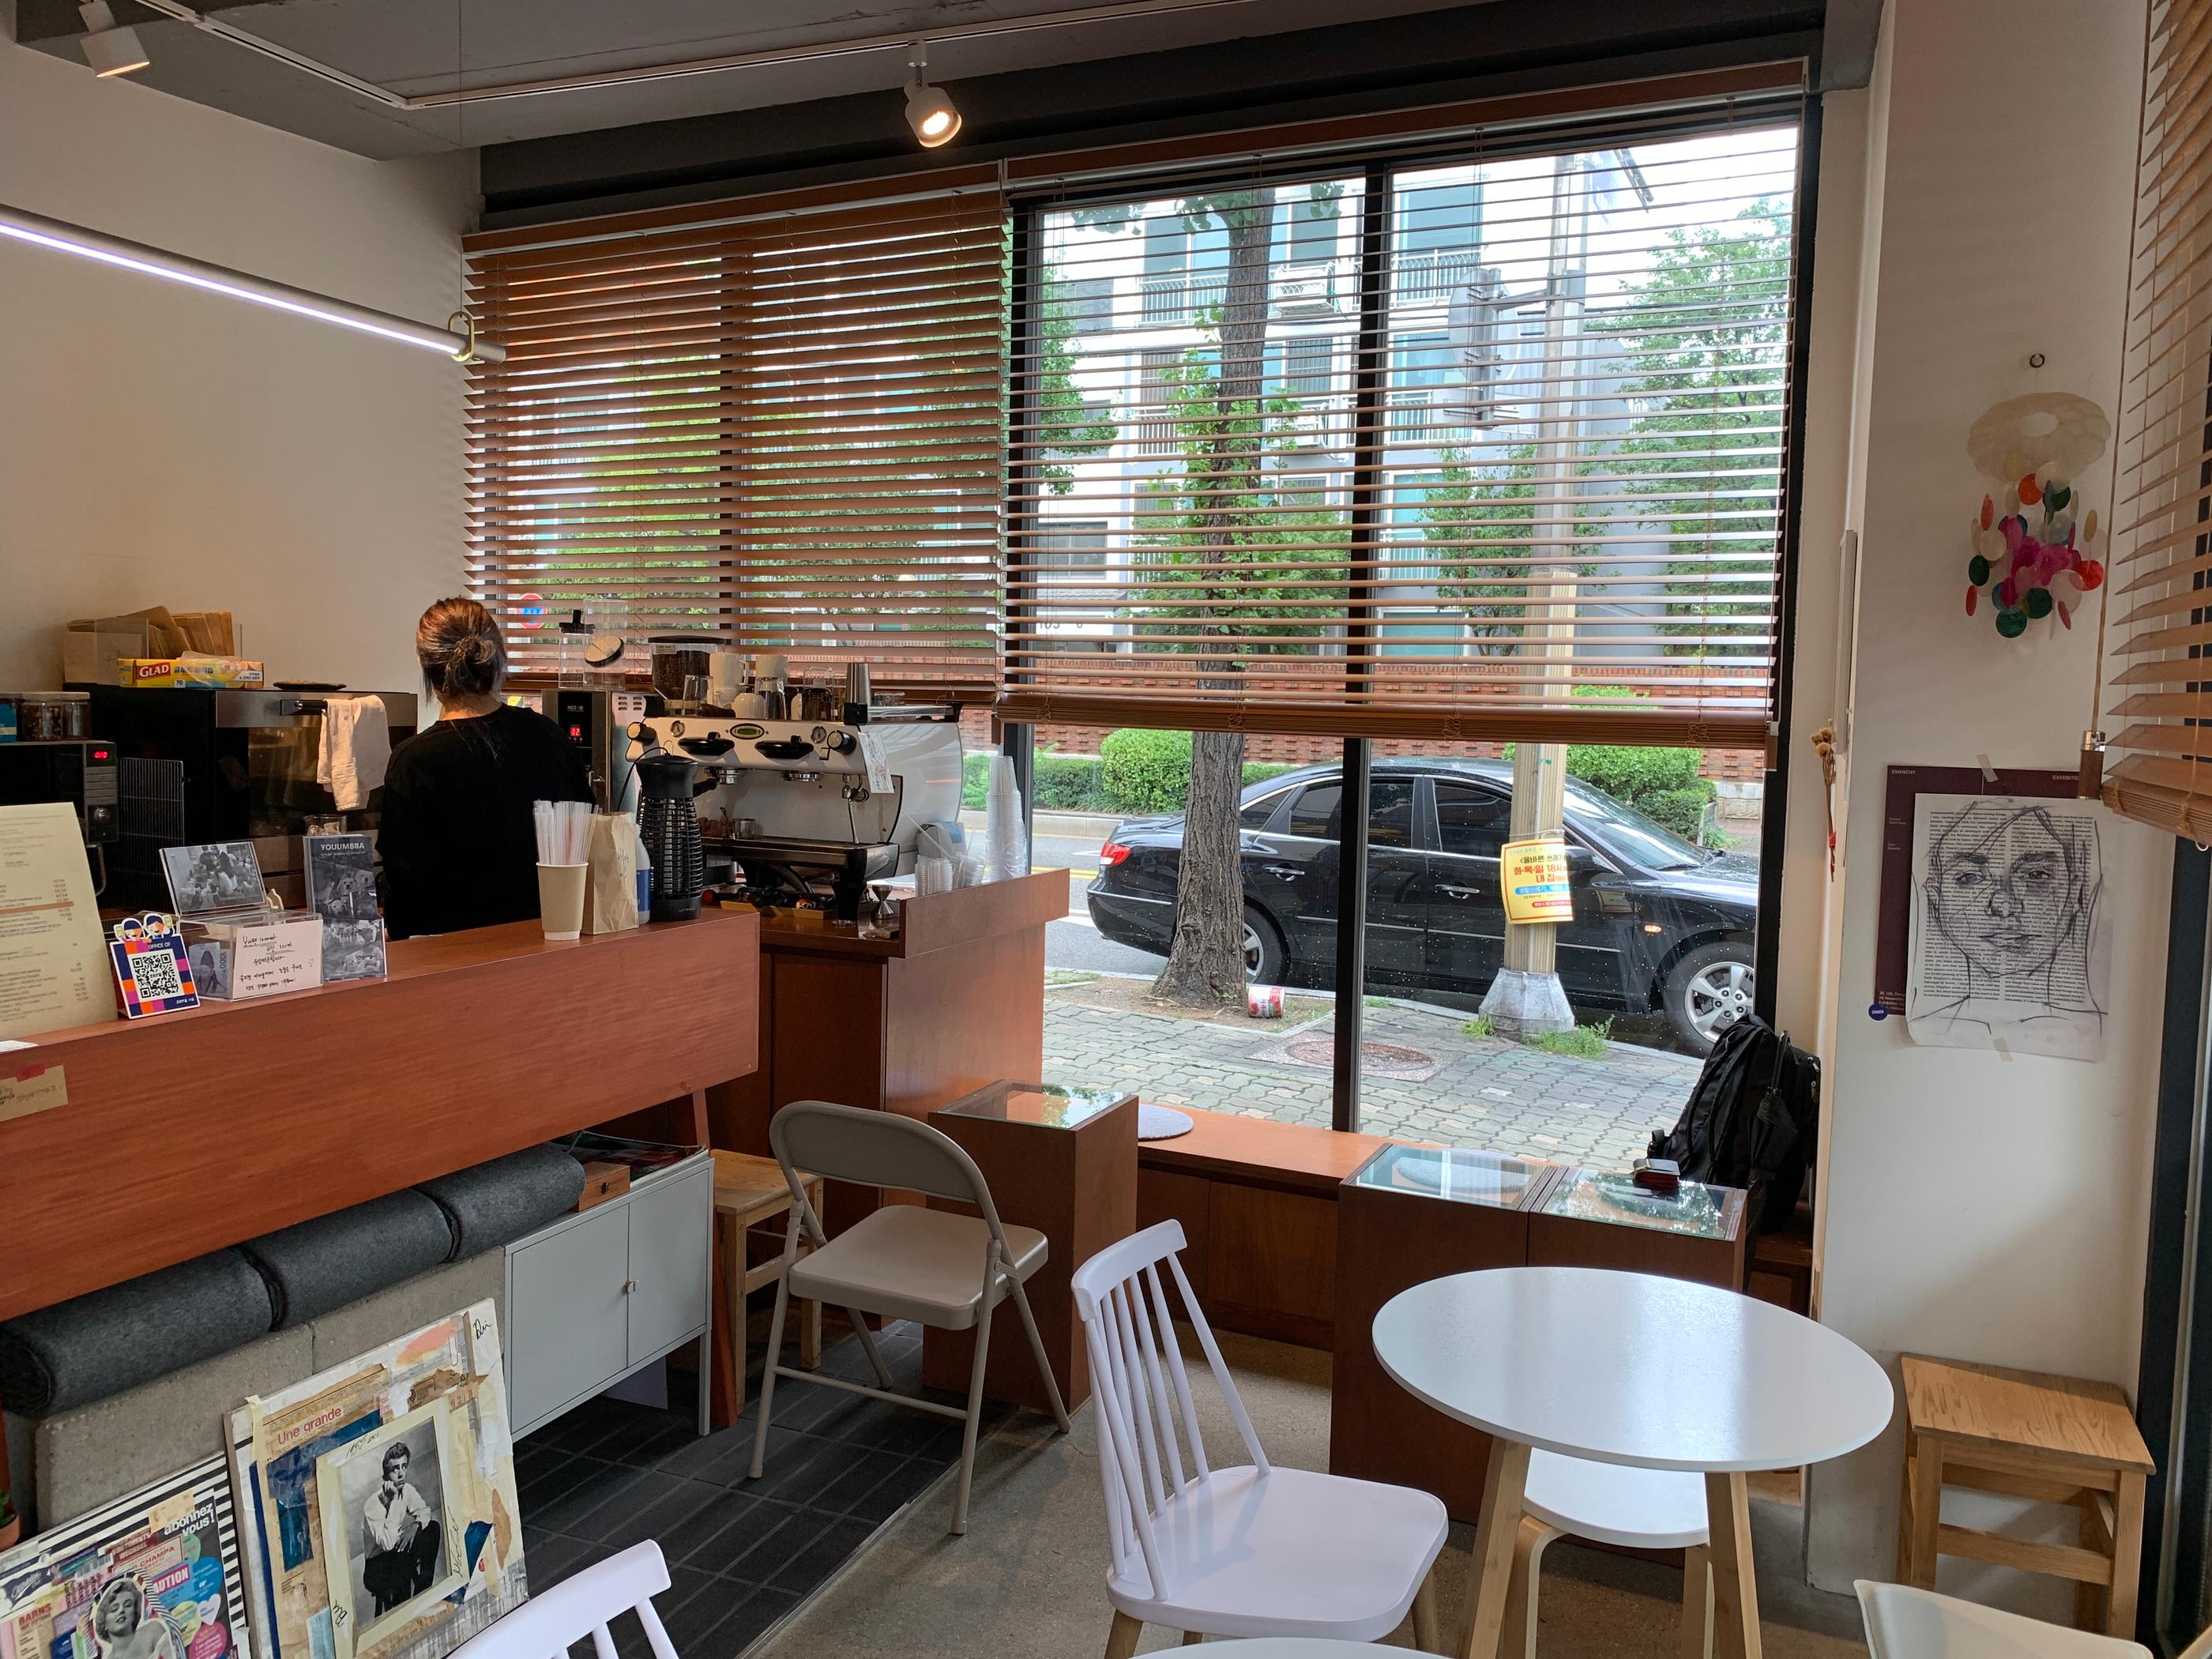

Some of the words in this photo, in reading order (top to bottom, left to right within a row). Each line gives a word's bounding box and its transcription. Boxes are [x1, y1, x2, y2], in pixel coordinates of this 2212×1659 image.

[139, 664, 170, 678] GLAD
[320, 842, 365, 851] YOUUMBBA
[278, 1426, 299, 1445] Une
[303, 1407, 342, 1432] grande
[164, 1503, 213, 1536] abonnez
[140, 1546, 175, 1567] CHAMPA
[152, 1567, 189, 1595] AUTION
